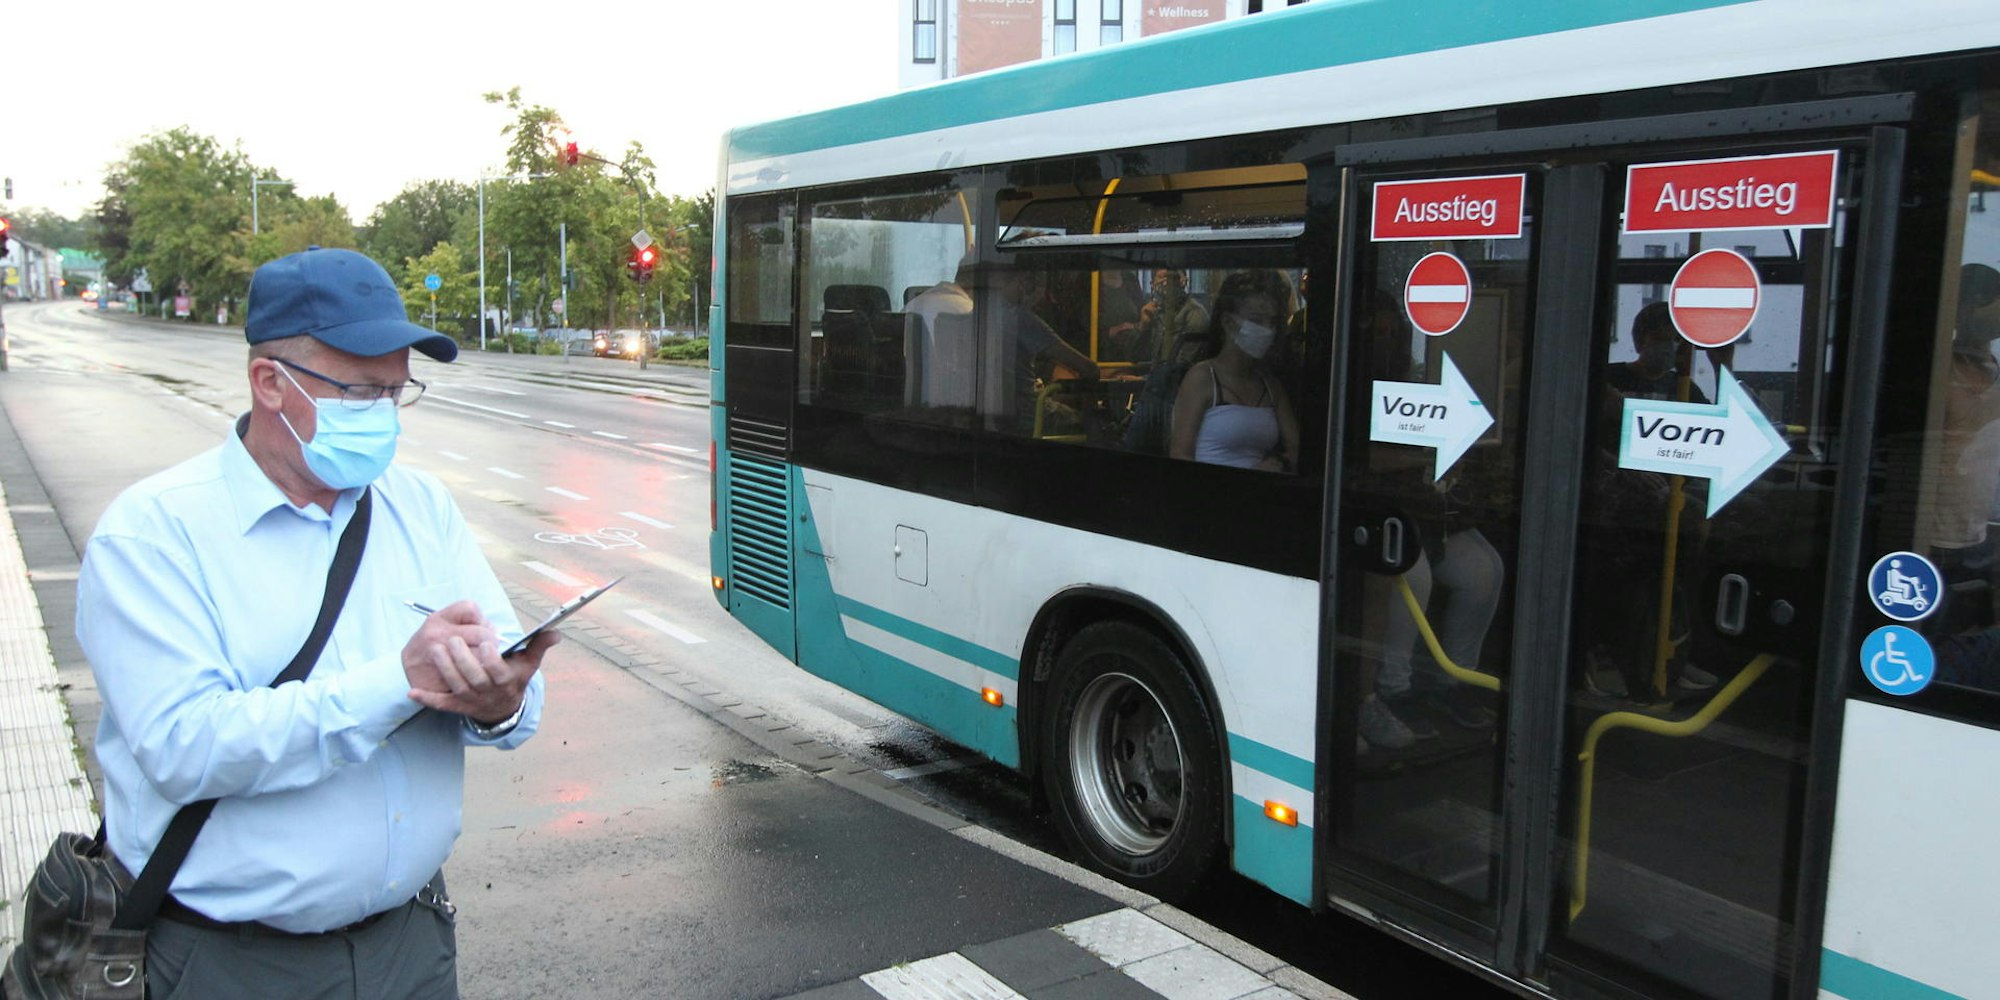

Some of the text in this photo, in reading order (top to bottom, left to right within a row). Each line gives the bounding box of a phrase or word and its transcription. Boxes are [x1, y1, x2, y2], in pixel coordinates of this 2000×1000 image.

[1158, 6, 1209, 17] Wellness
[1654, 177, 1797, 215] Ausstieg
[1394, 195, 1497, 226] Ausstieg
[1383, 396, 1447, 419] Vorn
[1398, 421, 1426, 433] ist fair!
[1637, 416, 1725, 446] Vorn
[1656, 447, 1694, 460] ist fair!
